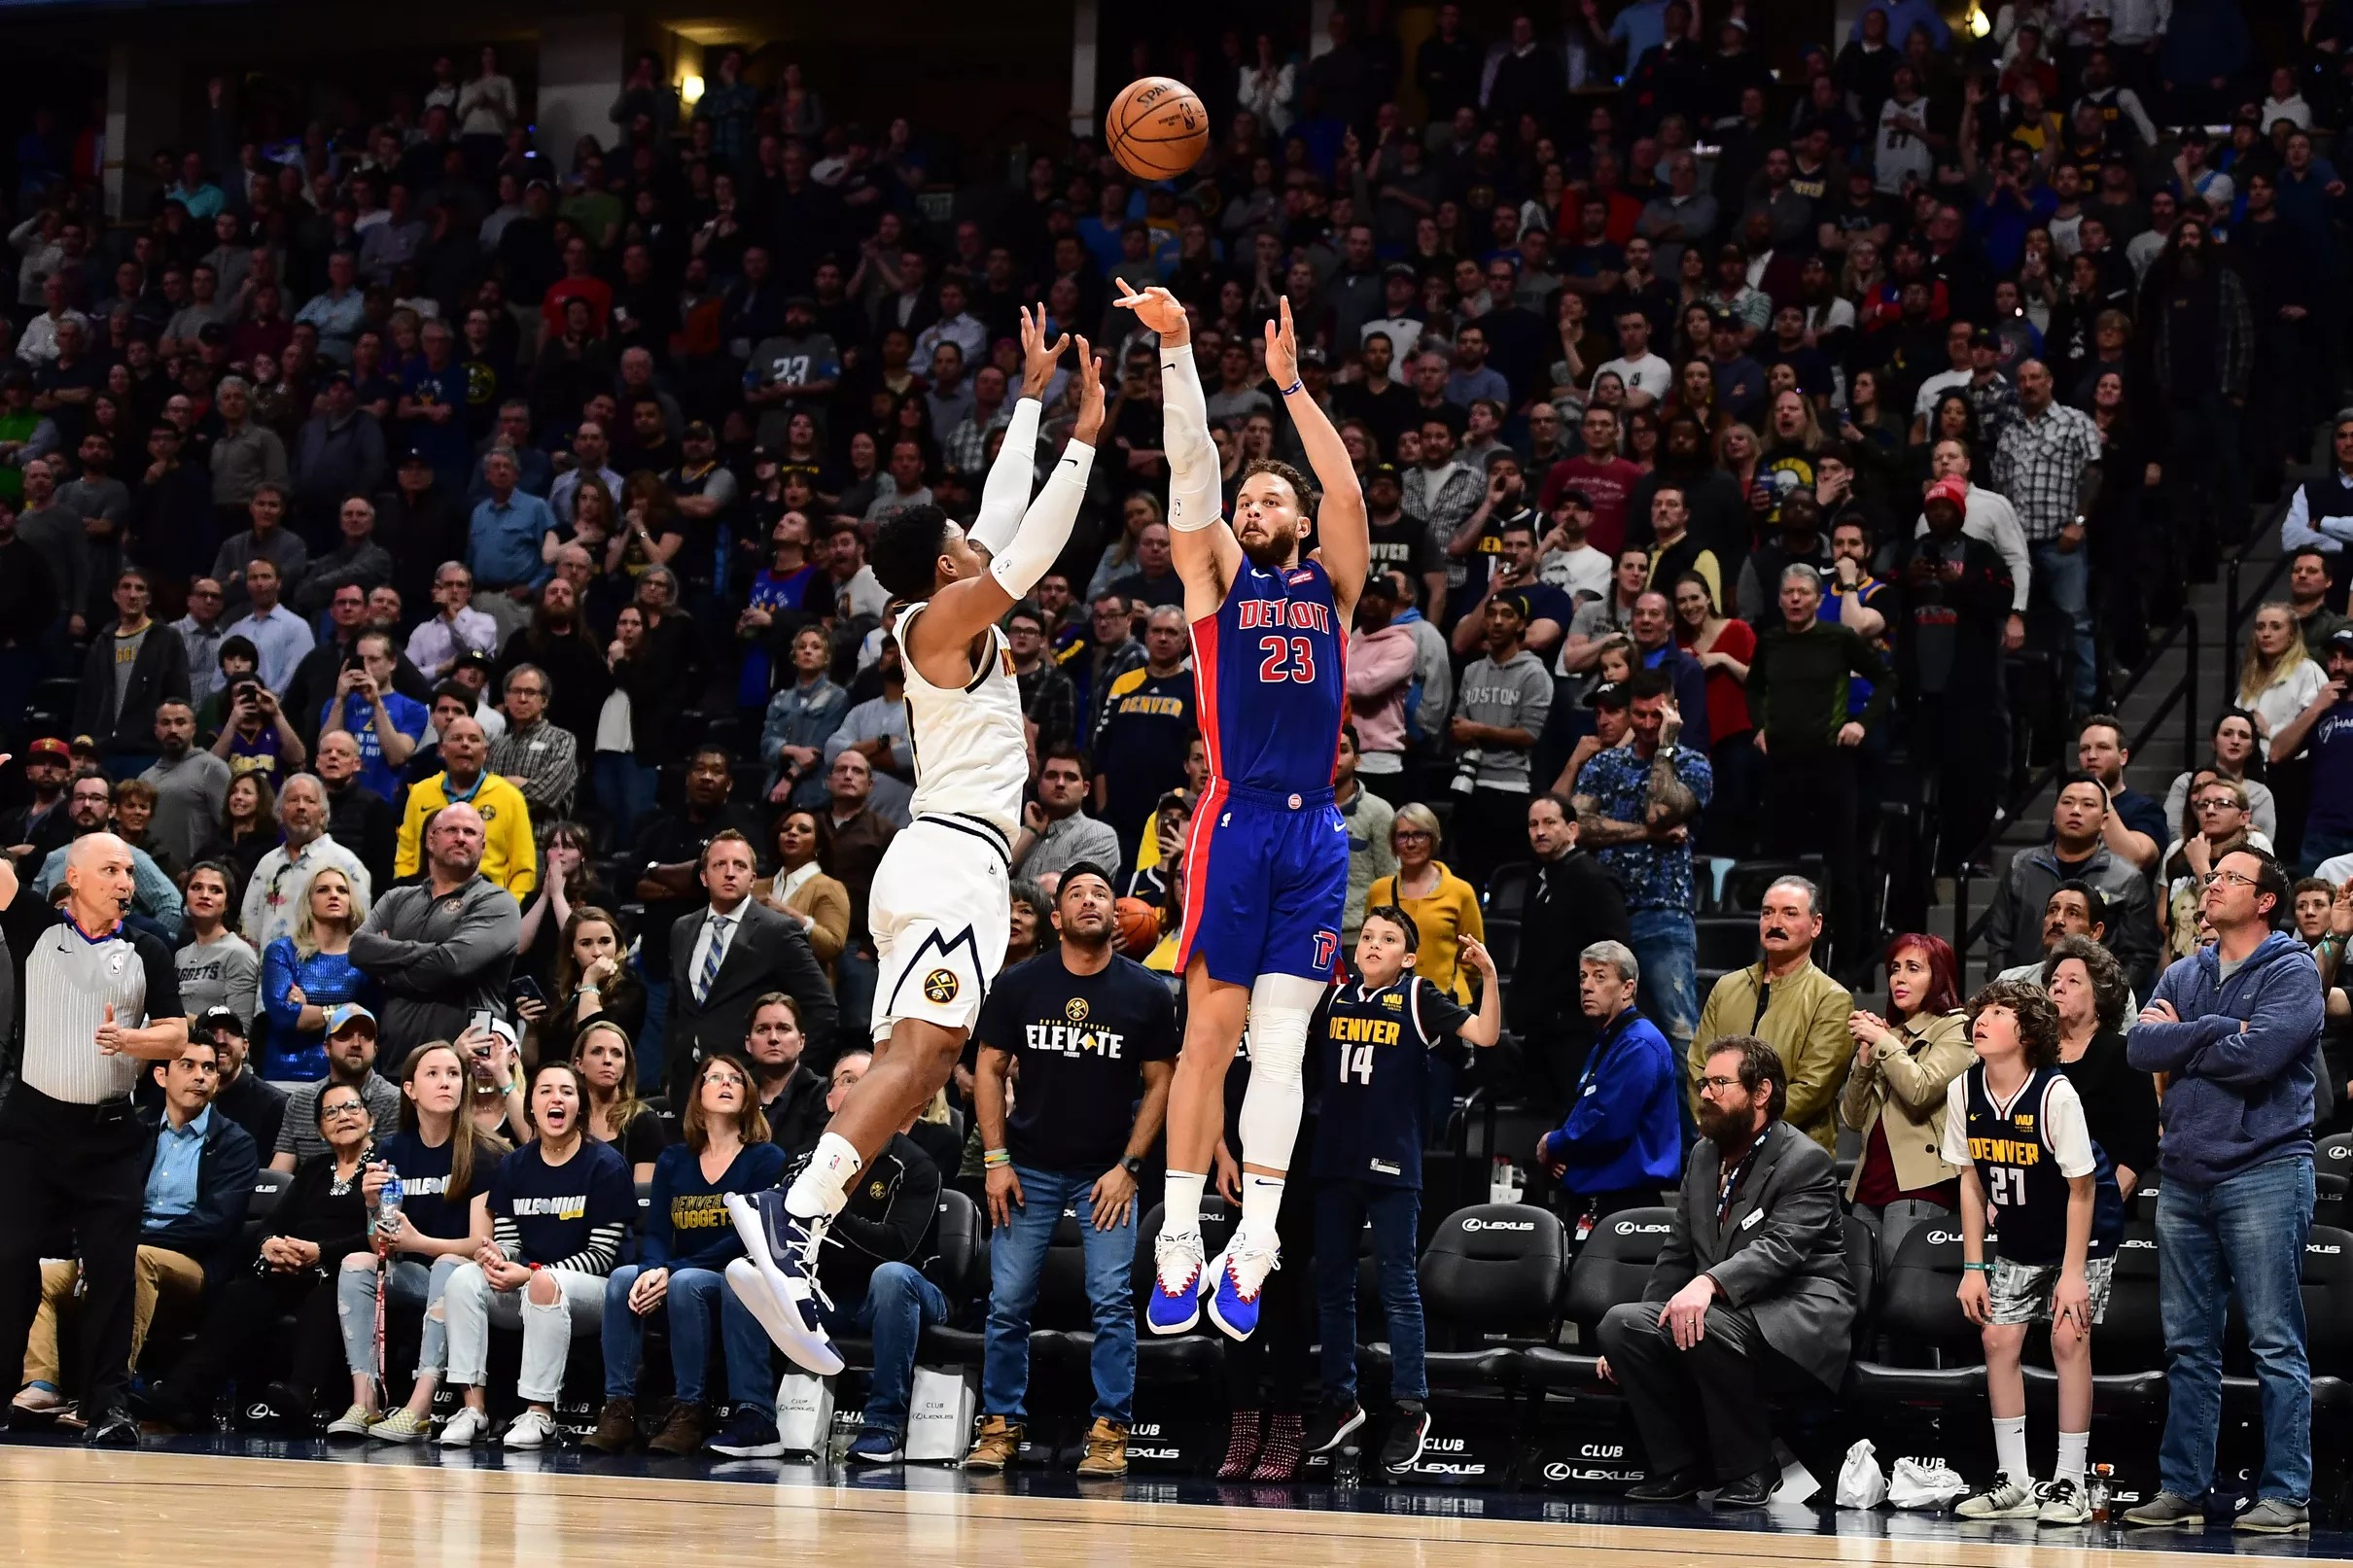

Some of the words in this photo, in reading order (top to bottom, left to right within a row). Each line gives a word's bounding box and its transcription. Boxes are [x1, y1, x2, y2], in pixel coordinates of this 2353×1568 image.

[771, 356, 809, 386] 23
[1238, 598, 1330, 635] DETROIT
[1259, 635, 1317, 683] 23
[1117, 696, 1180, 718] DENVER
[1329, 1017, 1400, 1046] DENVER
[1025, 1024, 1124, 1059] ELEVATE
[1340, 1045, 1373, 1085] 14
[2014, 1113, 2034, 1126] WU
[1967, 1137, 2039, 1166] DENVER
[1989, 1167, 2025, 1205] 27
[671, 1195, 722, 1213] DENVER
[1482, 1221, 1535, 1231] LEXUS
[1635, 1224, 1671, 1234] LEX
[1131, 1423, 1161, 1436] LUB
[1125, 1447, 1179, 1459] EXUS
[1422, 1438, 1465, 1452] CLUB
[1581, 1444, 1624, 1458] CLUB
[1413, 1462, 1486, 1475] LEXUS
[1572, 1468, 1645, 1481] LEXUS
